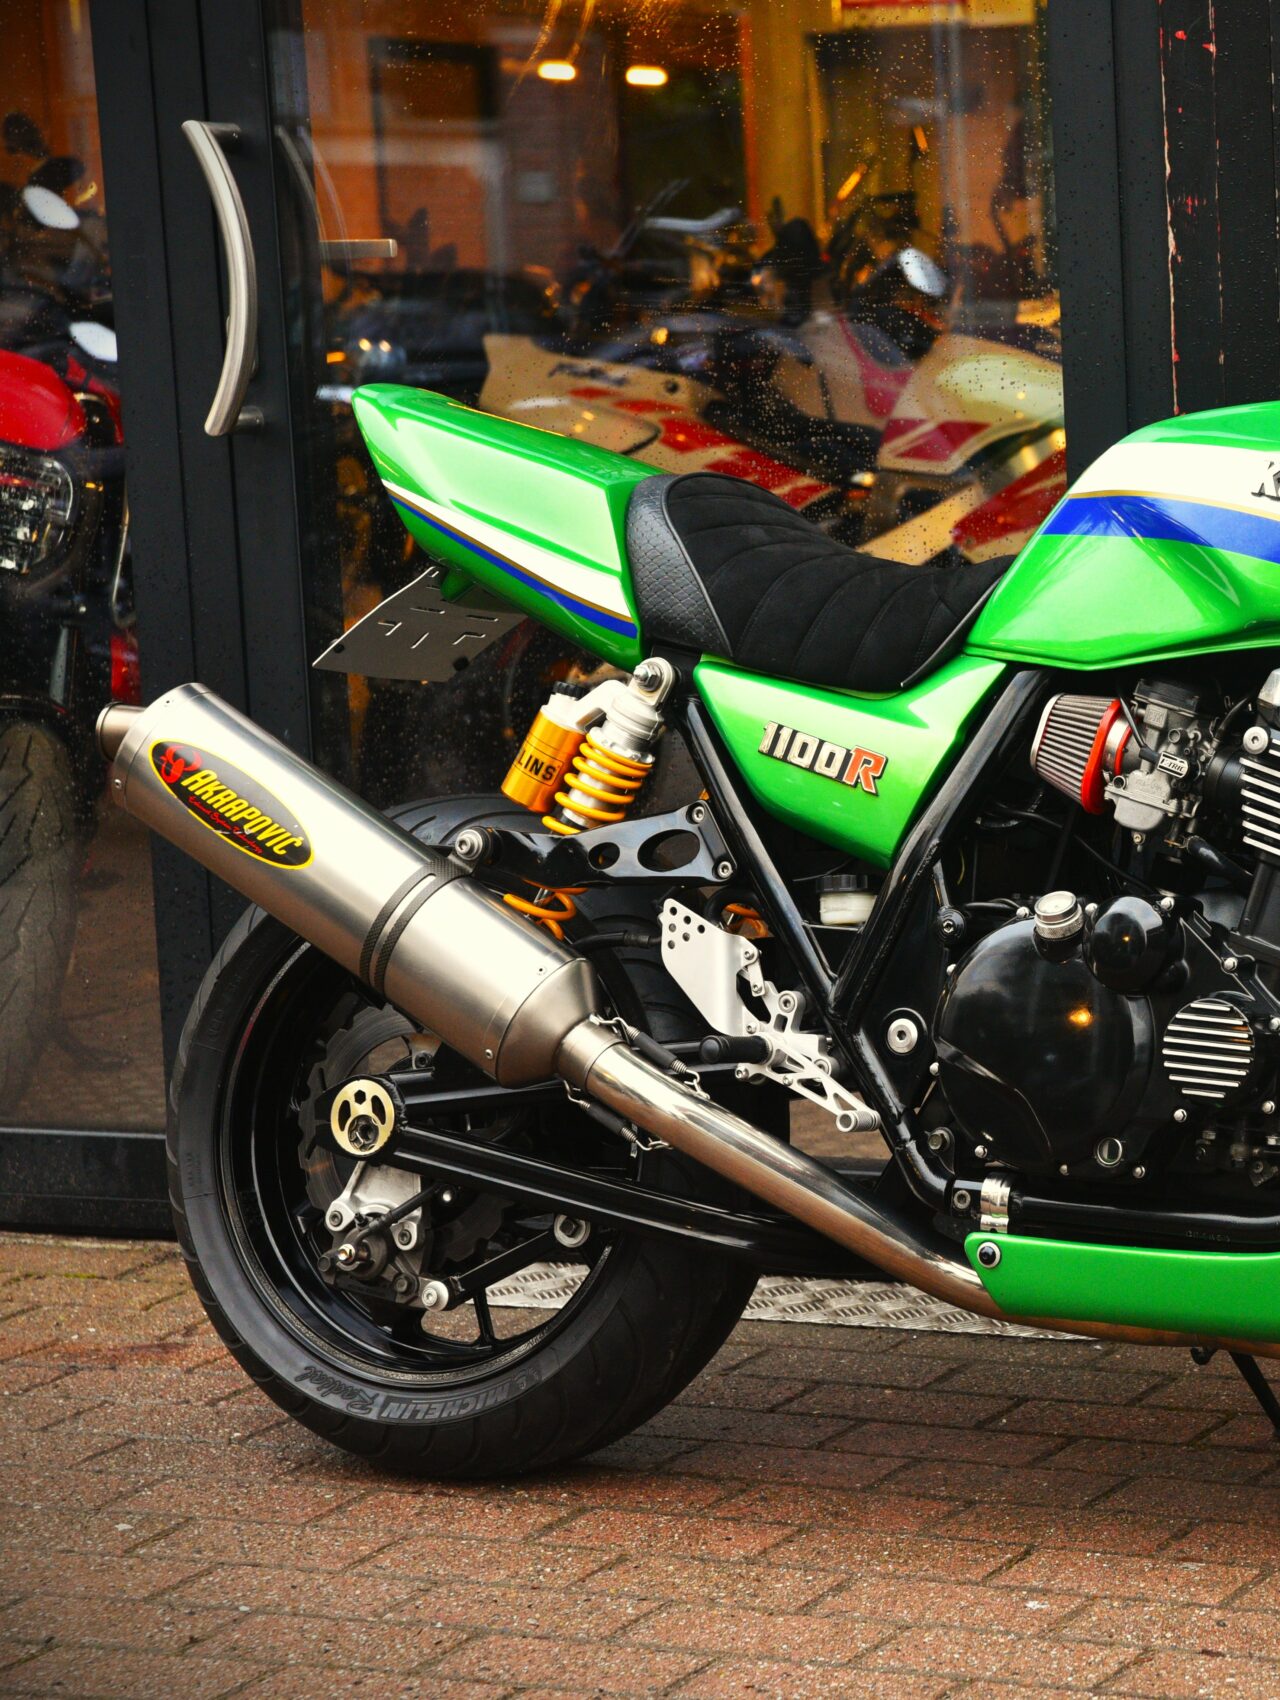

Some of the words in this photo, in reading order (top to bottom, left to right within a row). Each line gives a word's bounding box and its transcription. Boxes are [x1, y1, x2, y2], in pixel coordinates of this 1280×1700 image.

[758, 720, 888, 797] 1100R
[294, 1364, 374, 1416] Radial
[379, 1384, 512, 1421] MICHELIN
